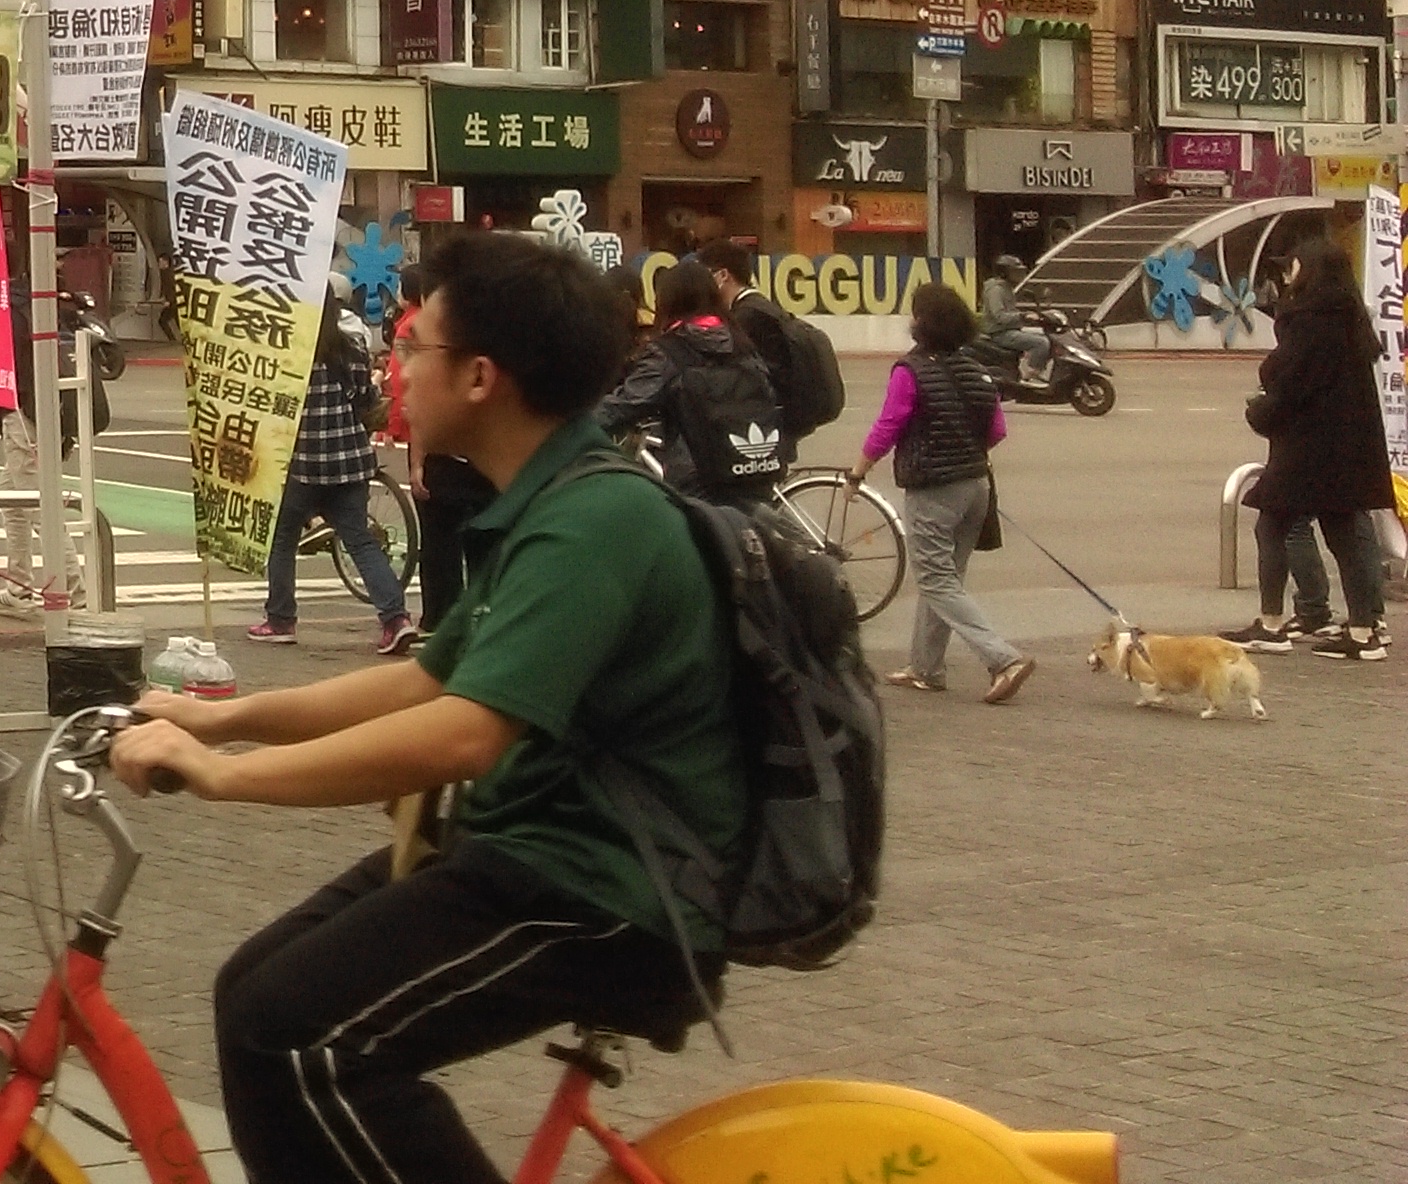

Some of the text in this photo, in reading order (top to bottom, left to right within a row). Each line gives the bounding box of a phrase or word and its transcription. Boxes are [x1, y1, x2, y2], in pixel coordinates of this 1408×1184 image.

[1216, 66, 1261, 101] 499
[1271, 76, 1303, 101] 300
[464, 111, 590, 150] 生活工場
[732, 456, 781, 476] adidas
